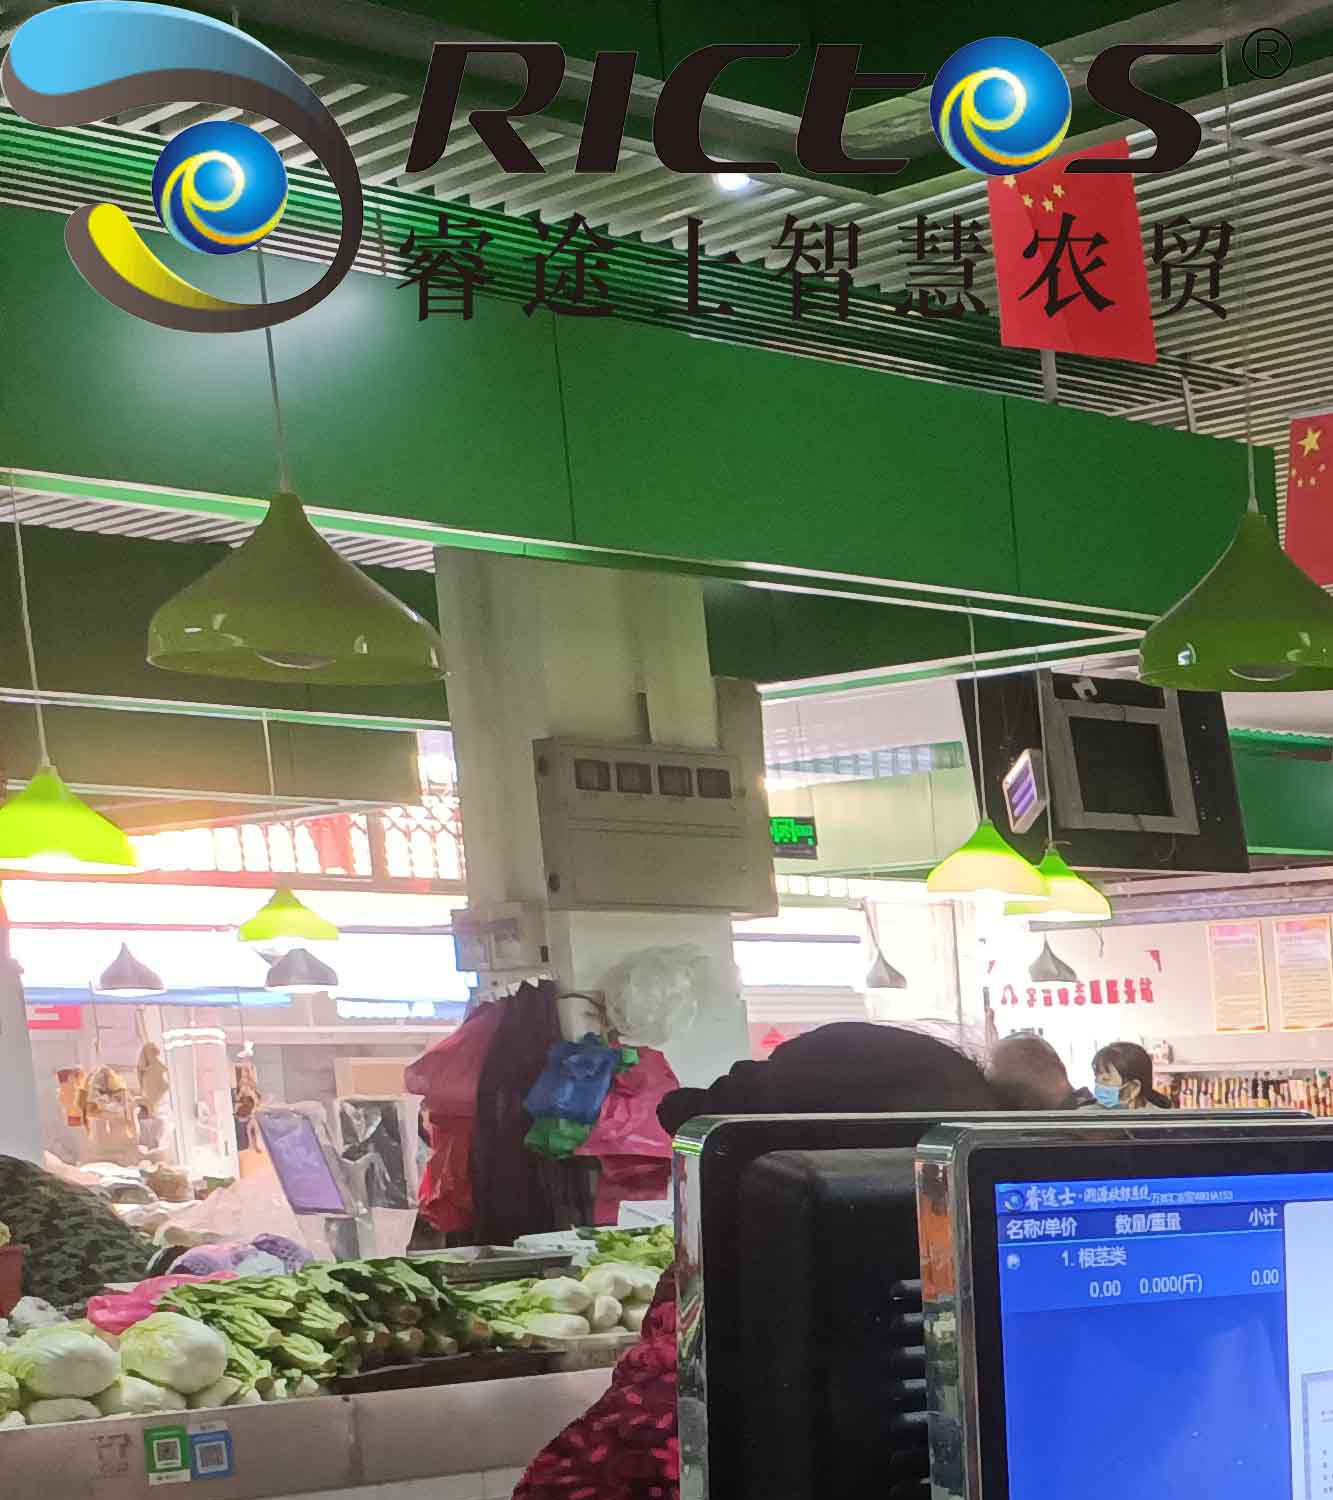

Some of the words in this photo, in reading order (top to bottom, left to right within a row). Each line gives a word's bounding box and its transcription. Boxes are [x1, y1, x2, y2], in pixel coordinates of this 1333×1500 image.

[1006, 1217, 1078, 1240] 名称/单价
[1115, 1212, 1182, 1234] 数量/重量
[1249, 1207, 1278, 1227] 小计
[1089, 1280, 1121, 1298] 0.00
[1139, 1274, 1203, 1295] 0.000(斤)
[1251, 1269, 1280, 1286] 0.00
